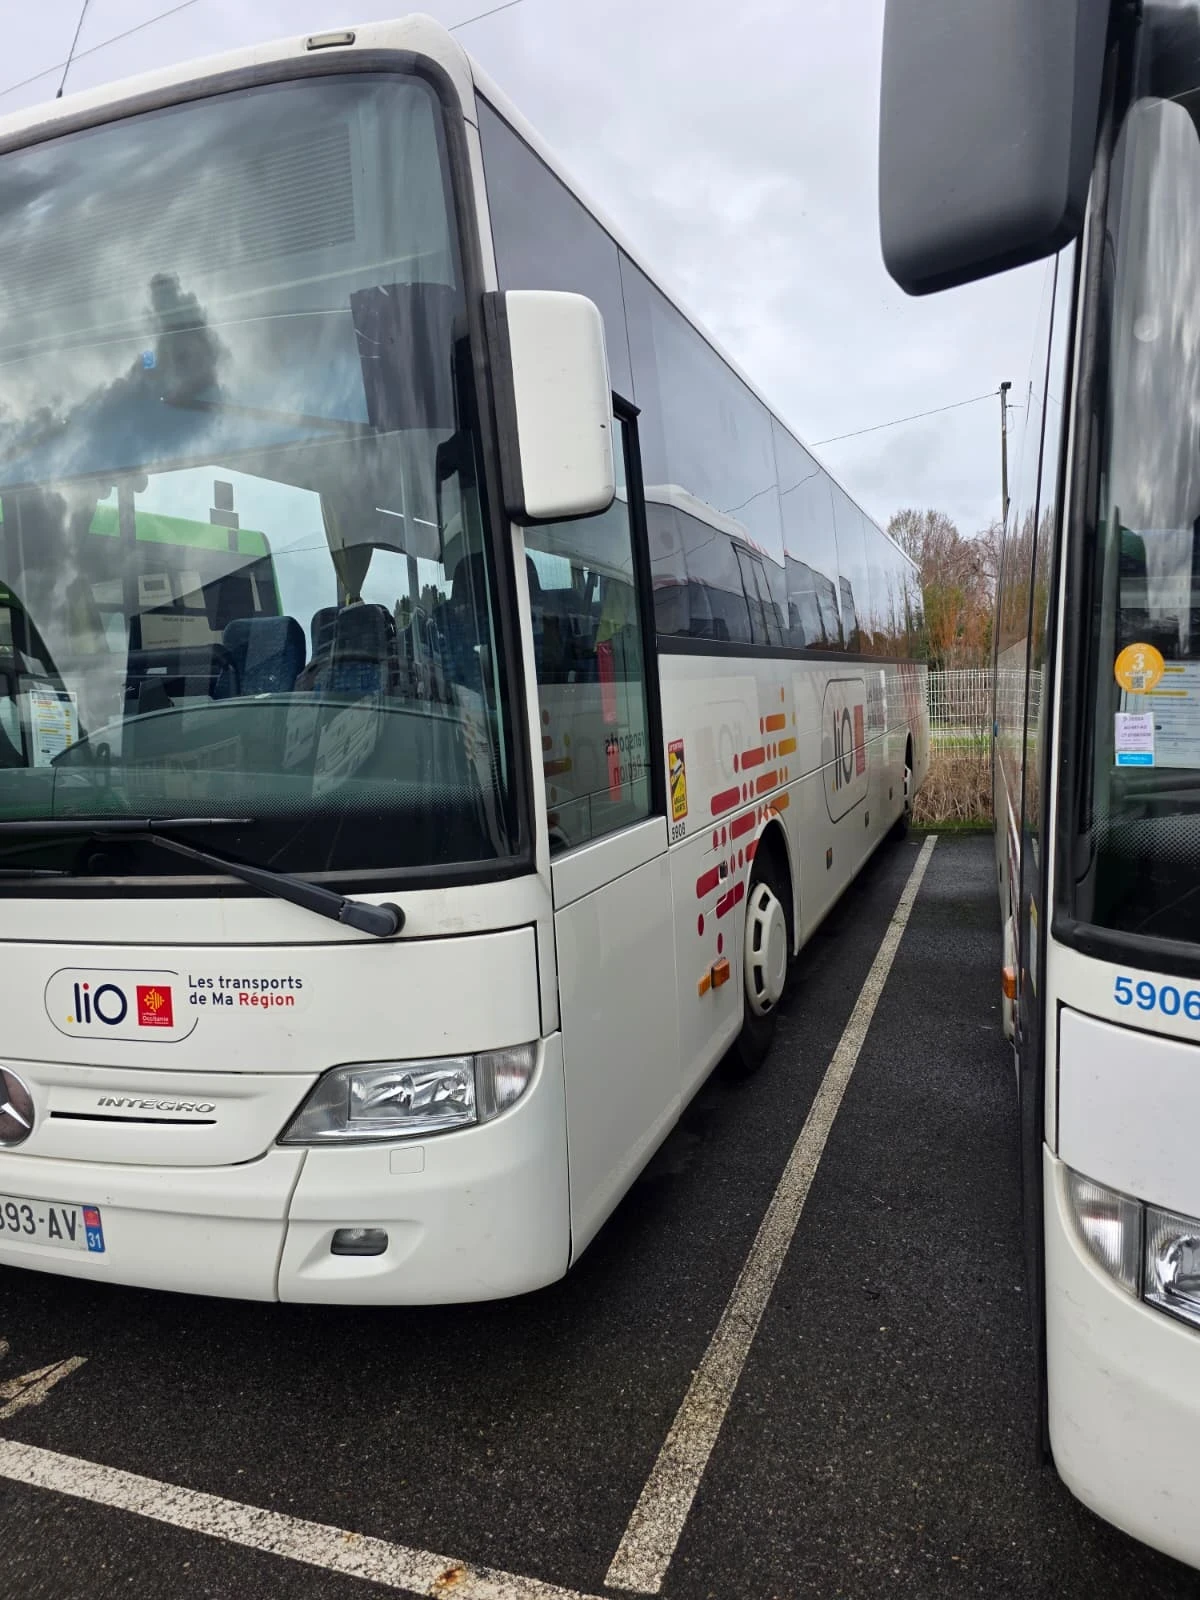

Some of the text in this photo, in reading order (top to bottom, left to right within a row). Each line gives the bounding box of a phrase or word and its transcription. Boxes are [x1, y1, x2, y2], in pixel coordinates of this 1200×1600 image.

[188, 975, 303, 992] Les transports
[189, 992, 294, 1009] de Ma Région
[1114, 975, 1200, 1021] 5906
[97, 1096, 216, 1113] INTEGRO
[88, 1232, 102, 1249] 31
